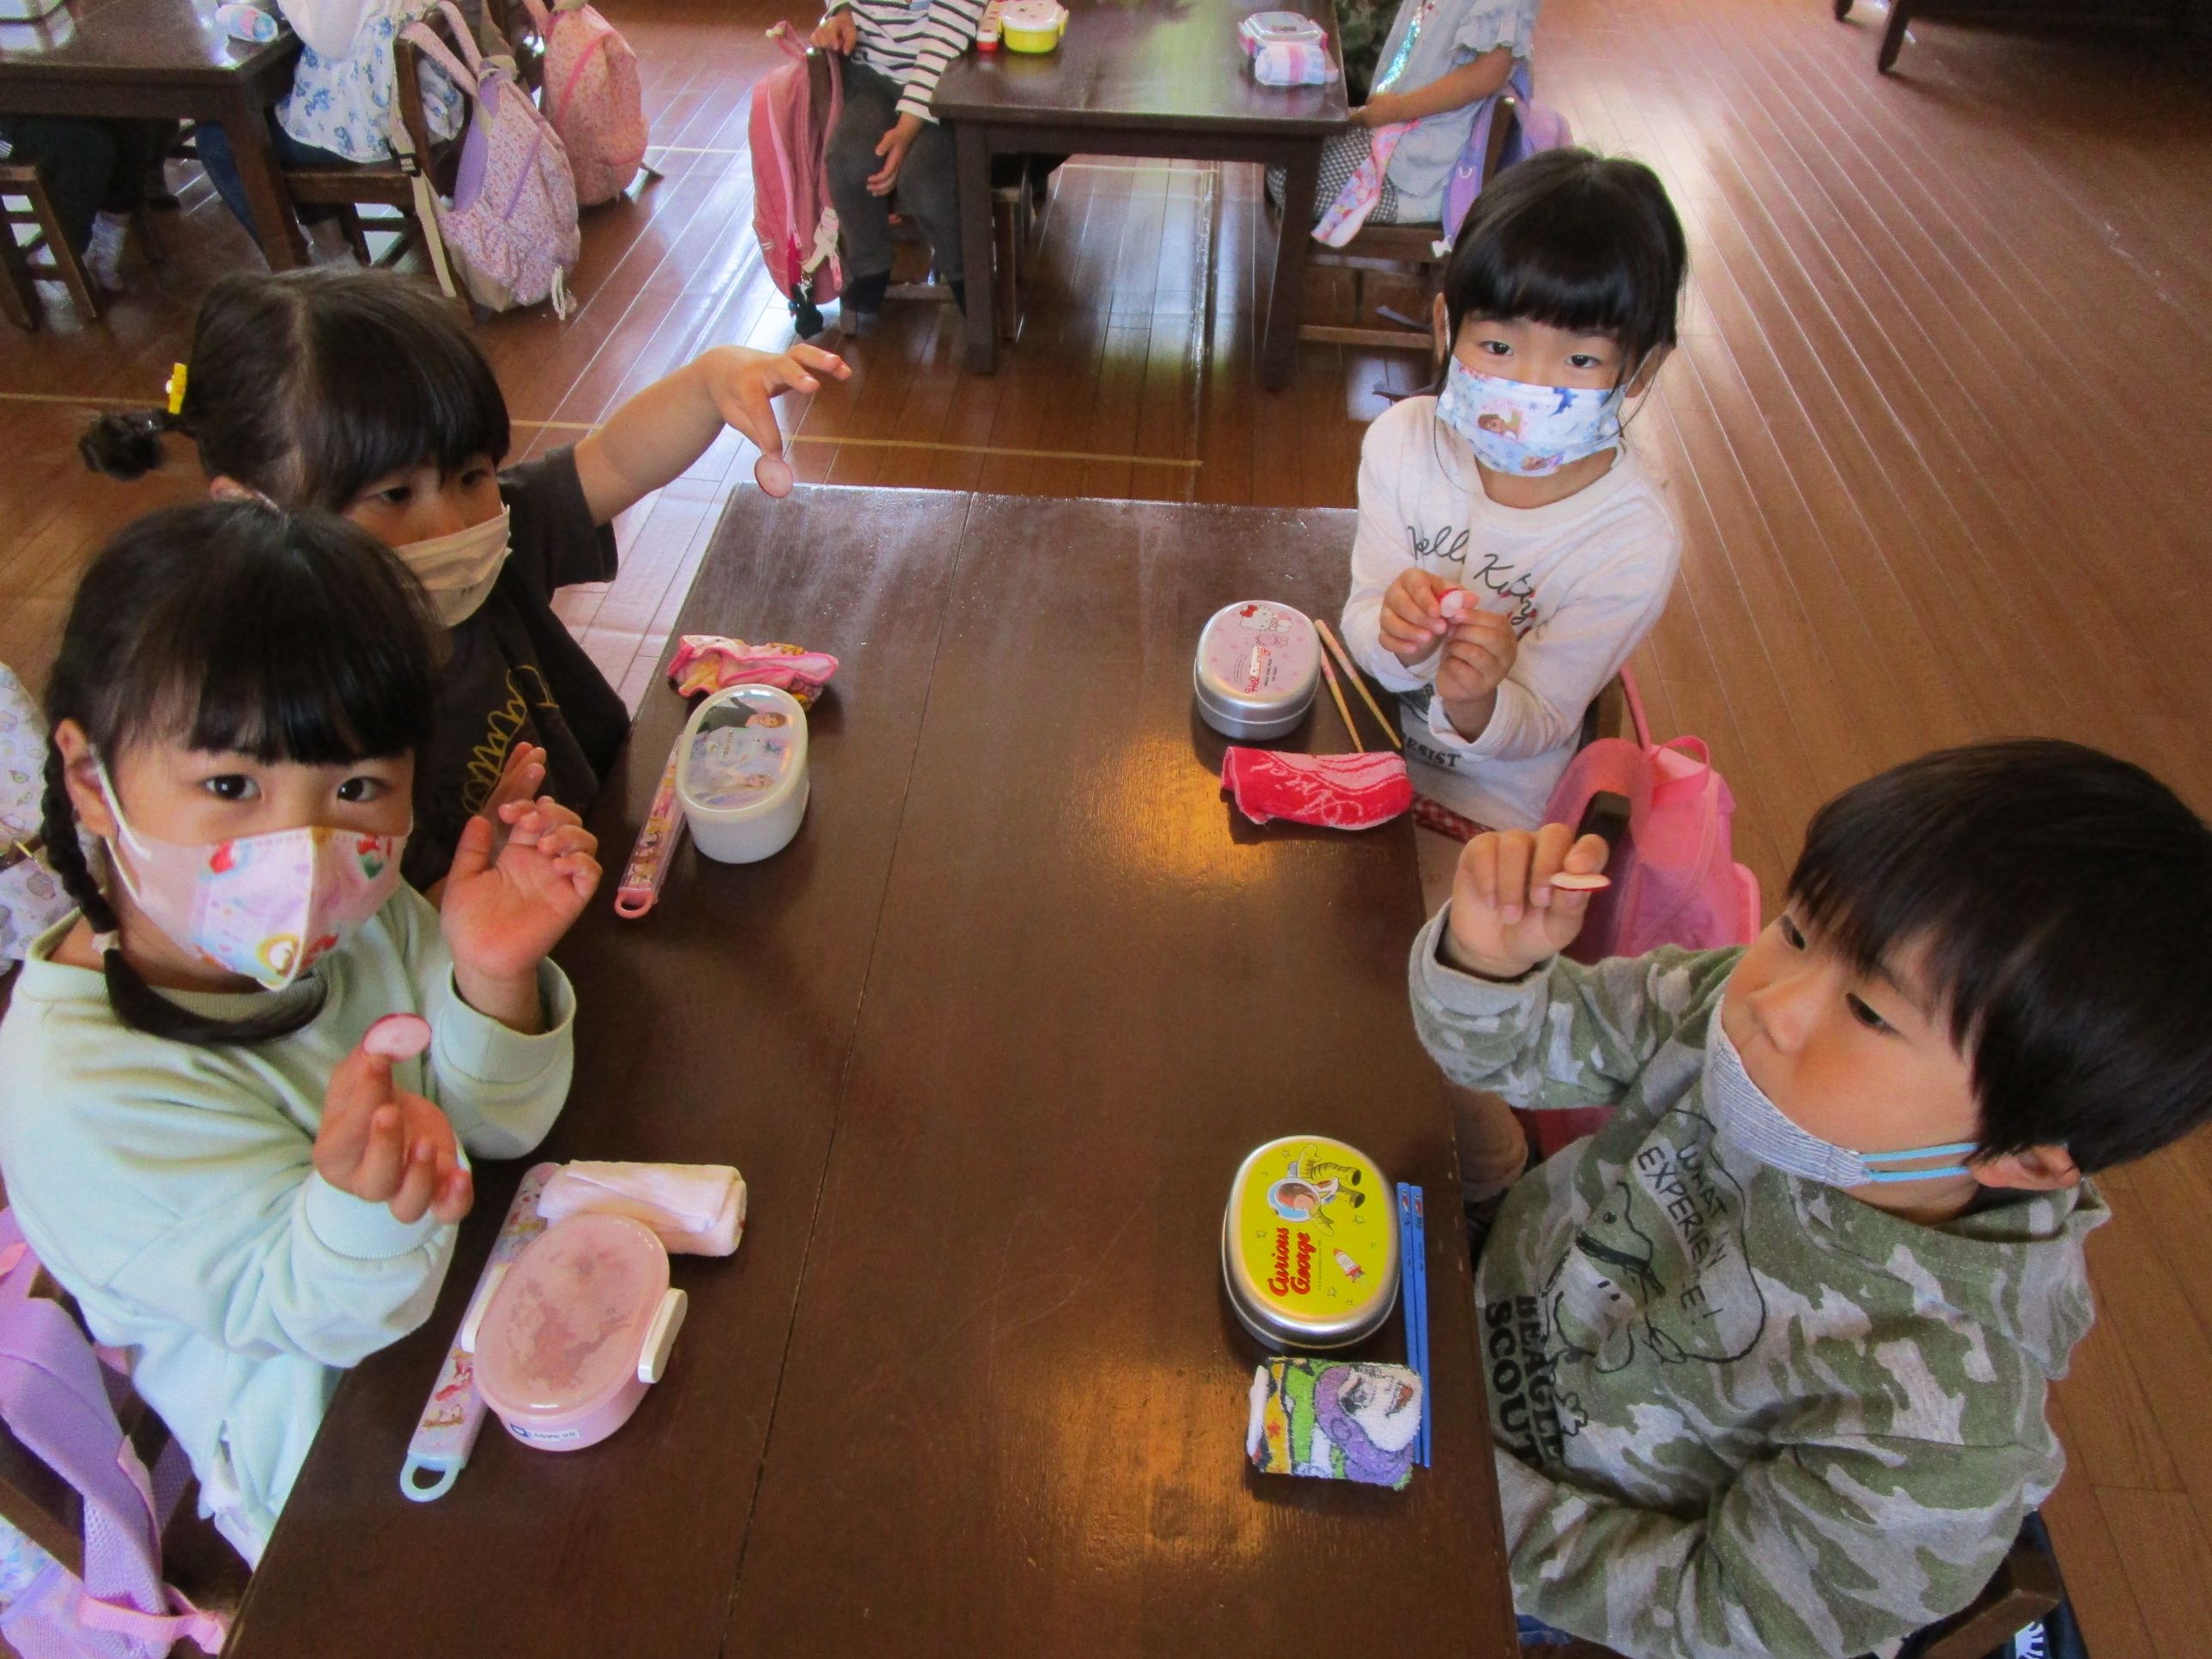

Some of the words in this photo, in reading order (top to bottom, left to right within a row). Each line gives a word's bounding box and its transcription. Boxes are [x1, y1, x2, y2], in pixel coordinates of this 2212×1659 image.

[1676, 1141, 1728, 1220] WHAT
[1267, 1227, 1290, 1297] Curious
[1290, 1231, 1317, 1295] George
[1484, 1301, 1544, 1463] SCOUT
[1515, 1295, 1565, 1460] BEAGLE
